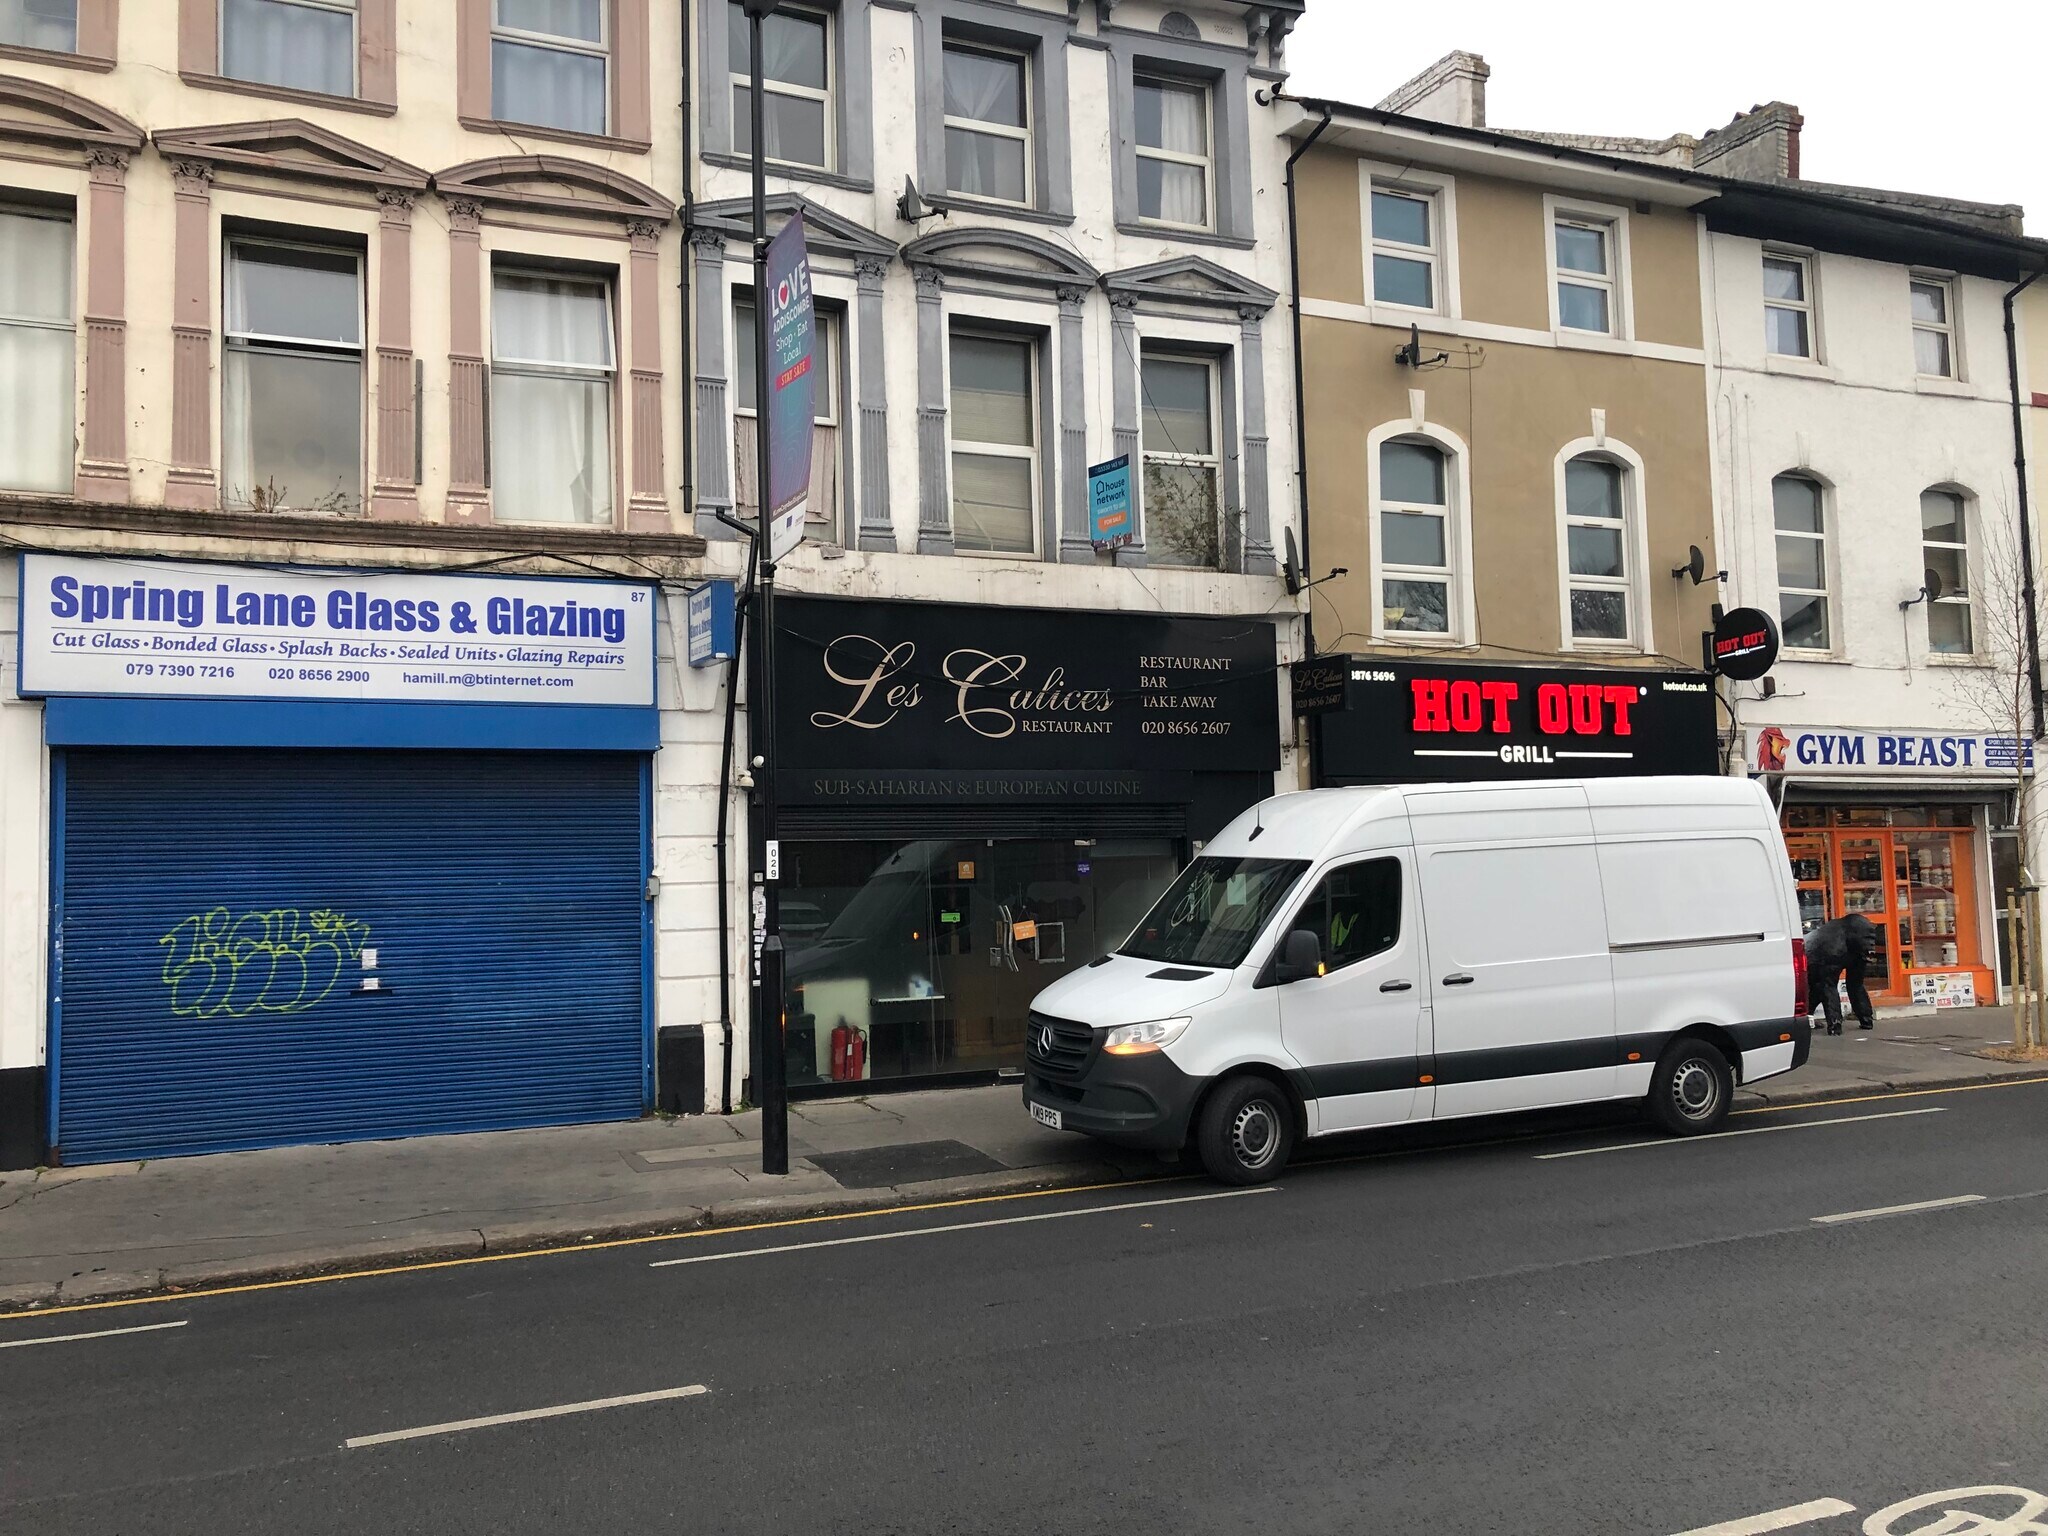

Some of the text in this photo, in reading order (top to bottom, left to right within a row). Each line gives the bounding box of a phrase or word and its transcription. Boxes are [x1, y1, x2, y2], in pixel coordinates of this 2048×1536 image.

[771, 260, 809, 318] LOVE
[773, 295, 810, 336] ADDISCOMBE
[775, 320, 808, 352] Shop Eat
[783, 342, 801, 365] Local
[793, 361, 806, 379] SAFE
[1105, 478, 1125, 492] house
[1096, 489, 1125, 505] network
[631, 592, 645, 602] 87
[50, 575, 625, 643] Spring Lane Glass & Glazing
[52, 632, 625, 667] Cut Glass Bonded Glass Splash Backs Sealed Units Glazing Repairs
[1716, 630, 1766, 653] HOT OUT
[1735, 648, 1750, 656] GRILL
[126, 663, 235, 678] 079 7390 7216
[1140, 656, 1232, 670] RESTAURANT
[268, 668, 370, 683] 020 8656 2900
[403, 672, 573, 688] hamill.m@btinternet.com
[1140, 676, 1168, 688] BAR
[1372, 671, 1396, 682] 5696
[810, 634, 1114, 739] Les Calices
[1662, 681, 1708, 692] hotout.co.uk
[1141, 695, 1217, 709] TAKE AWAY
[1410, 679, 1638, 736] HOT OUT
[1022, 720, 1113, 733] RESTAURANT
[1141, 721, 1231, 735] 020 8656 2607
[1500, 745, 1554, 764] GRILL
[1796, 733, 1977, 767] GYM BEAST
[814, 779, 1141, 795] SUB-SAHARIAN & EUROPEAN CUISINE
